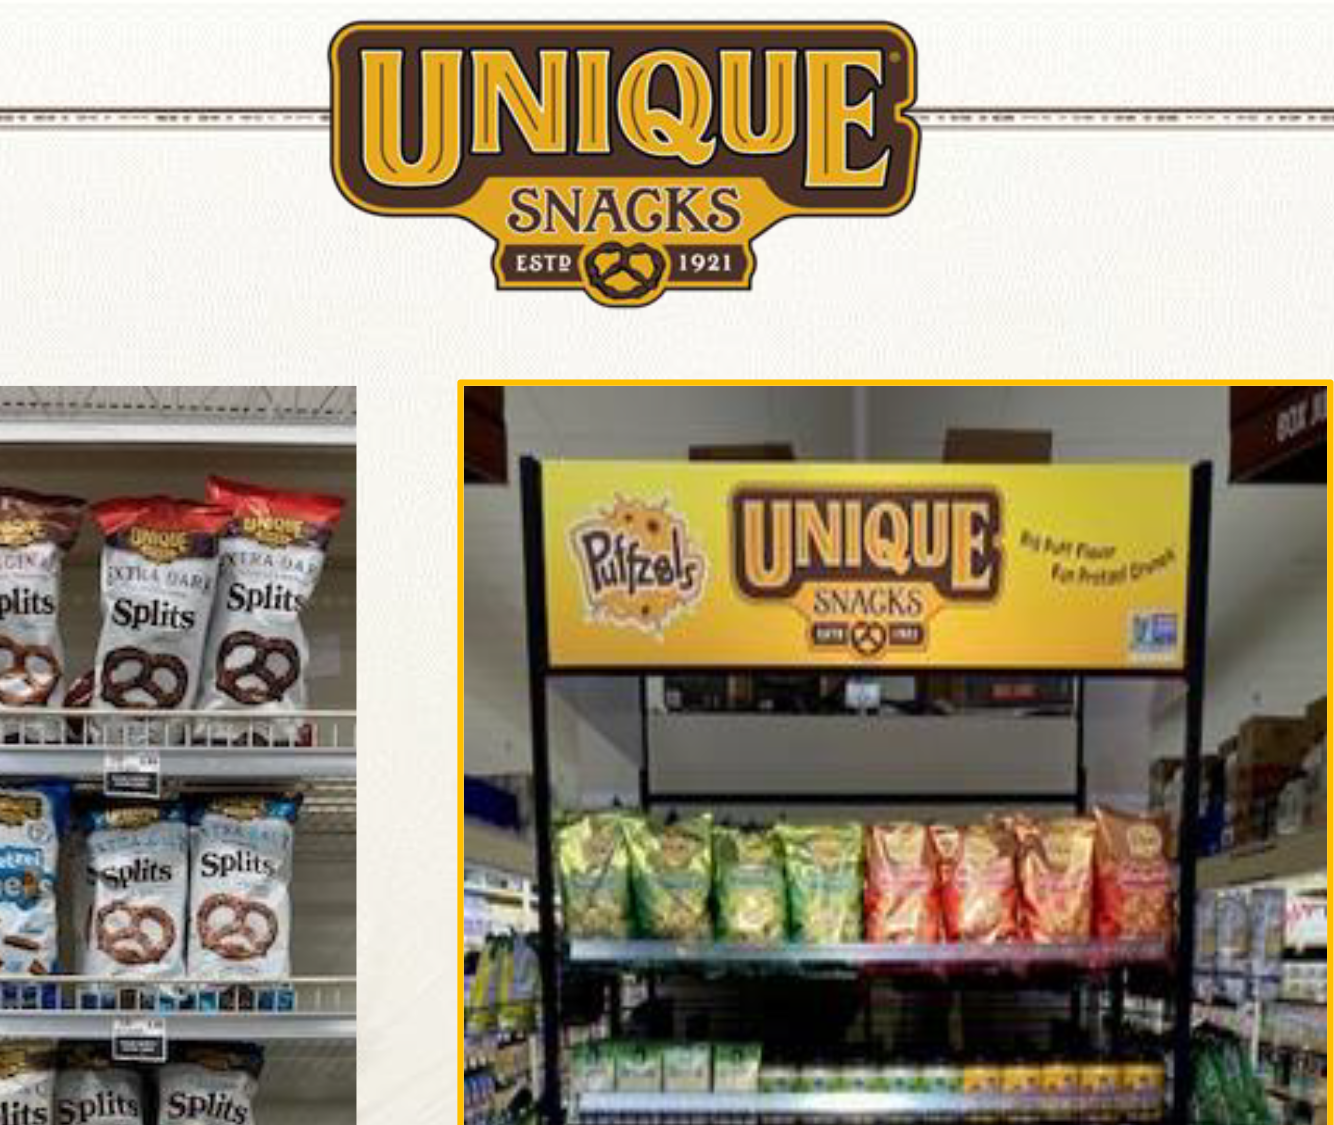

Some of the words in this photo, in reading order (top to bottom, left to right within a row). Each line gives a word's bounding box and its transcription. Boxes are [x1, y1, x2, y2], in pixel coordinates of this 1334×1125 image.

[582, 527, 696, 595] Puffzels
[743, 497, 994, 592] UNIQUE
[111, 596, 196, 630] Splits
[226, 581, 307, 613] Splits
[814, 589, 923, 616] SNACKS
[87, 857, 172, 889] Splits
[200, 851, 275, 878] Splits
[59, 1091, 139, 1125] Splits
[168, 1091, 248, 1125] Splits
